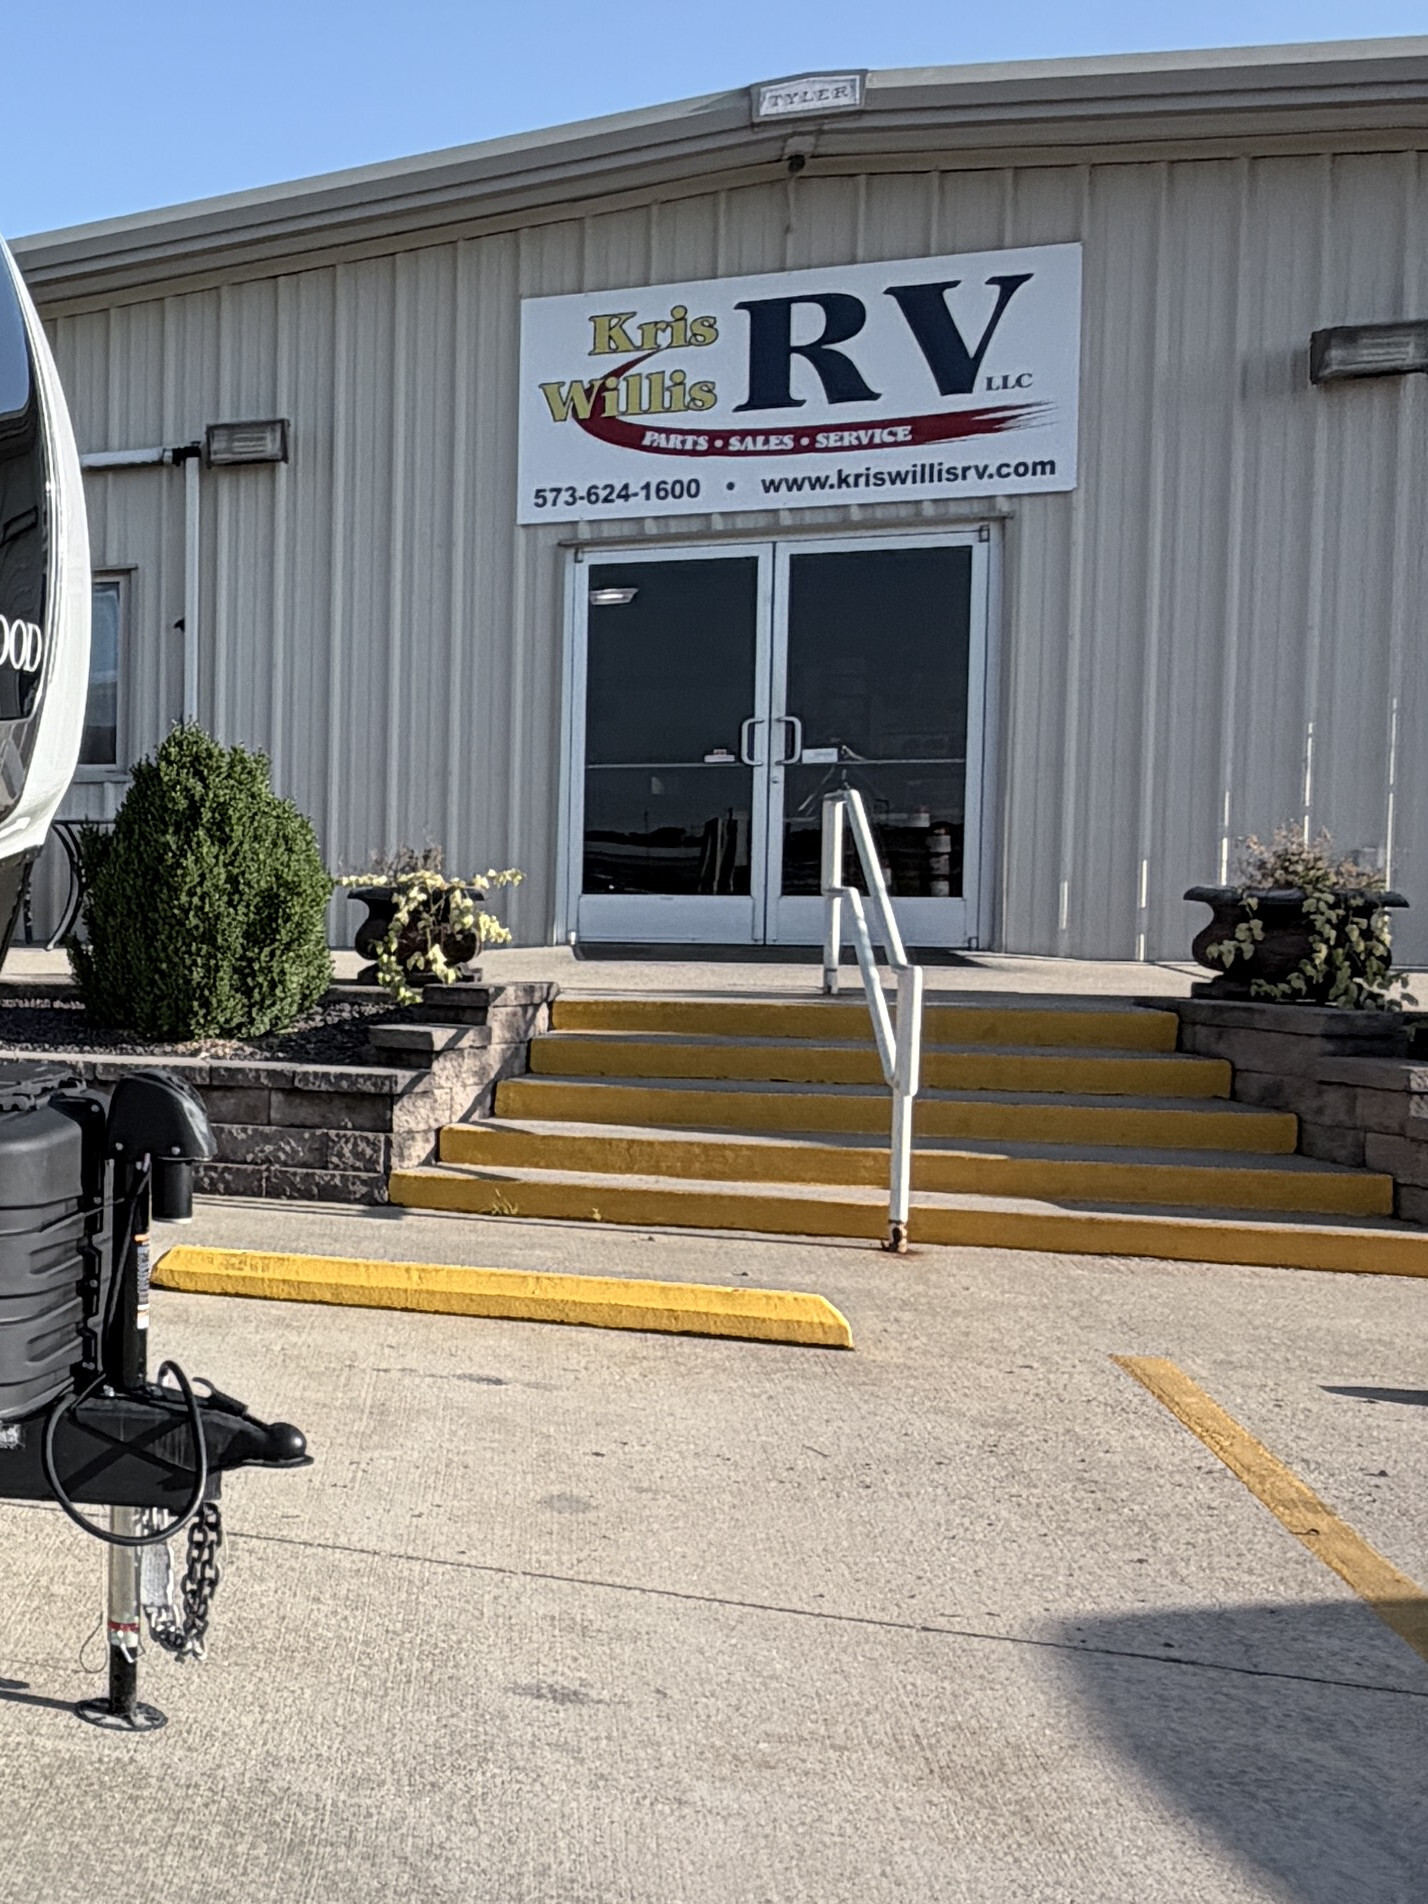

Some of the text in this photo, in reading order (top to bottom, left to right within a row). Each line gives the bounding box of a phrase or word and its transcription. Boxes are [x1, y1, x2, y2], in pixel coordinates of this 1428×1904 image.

[768, 85, 849, 107] TYLER
[587, 304, 720, 356] Kris
[732, 272, 1035, 412] RV
[538, 369, 718, 423] Willis
[984, 372, 1034, 392] LLC
[641, 425, 913, 452] PARTS SALES SERVICE
[533, 458, 1057, 509] 573-624-1600 www.kriswillisrv.com
